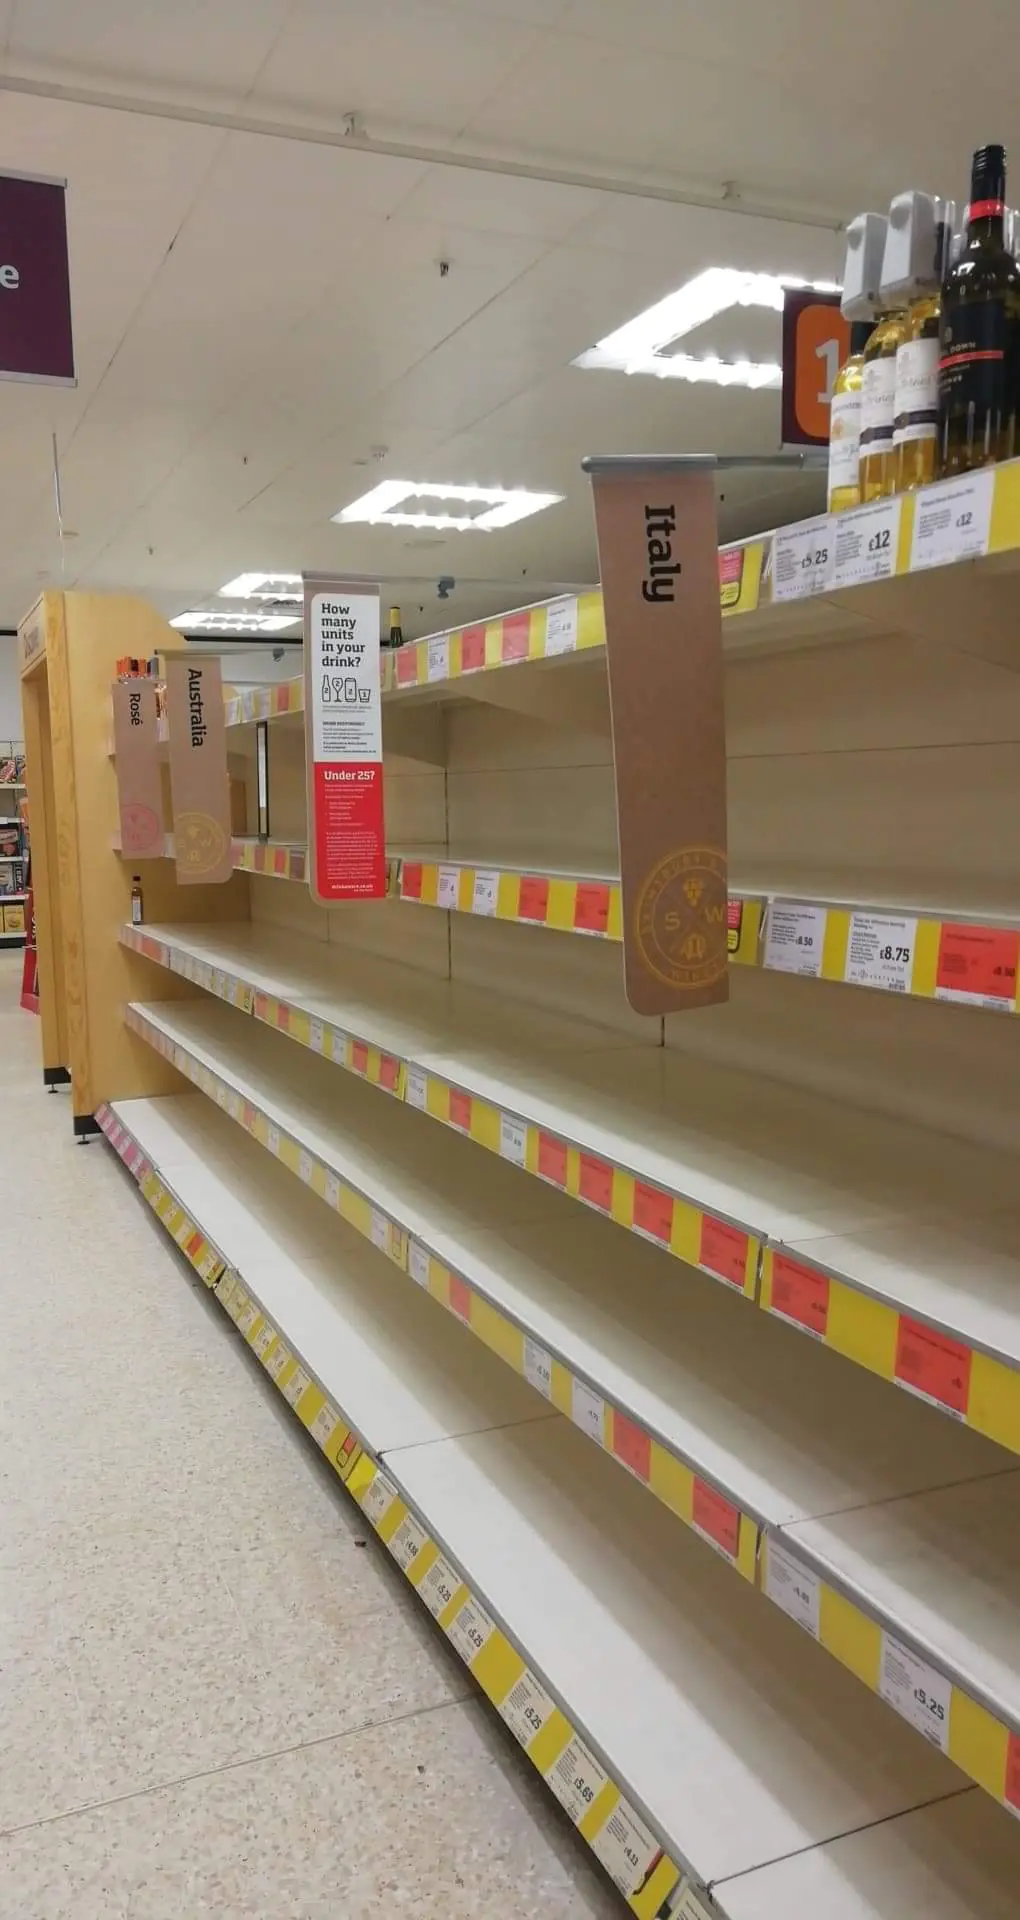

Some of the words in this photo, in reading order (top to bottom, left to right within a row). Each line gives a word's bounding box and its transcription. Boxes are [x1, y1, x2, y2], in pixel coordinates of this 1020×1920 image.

[868, 528, 890, 552] £12
[642, 504, 682, 602] Italy
[321, 603, 350, 615] How
[321, 617, 356, 630] many
[321, 628, 354, 640] units
[321, 640, 334, 652] in
[336, 643, 366, 655] your
[321, 656, 361, 667] drink?
[129, 693, 143, 726] Rosé
[188, 668, 207, 747] Australia
[324, 771, 356, 780] Under
[357, 771, 376, 780] 25?
[879, 946, 910, 963] £8.75
[913, 1688, 945, 1721] £5.25
[524, 1707, 542, 1730] £5.25
[574, 1778, 594, 1803] £5.65
